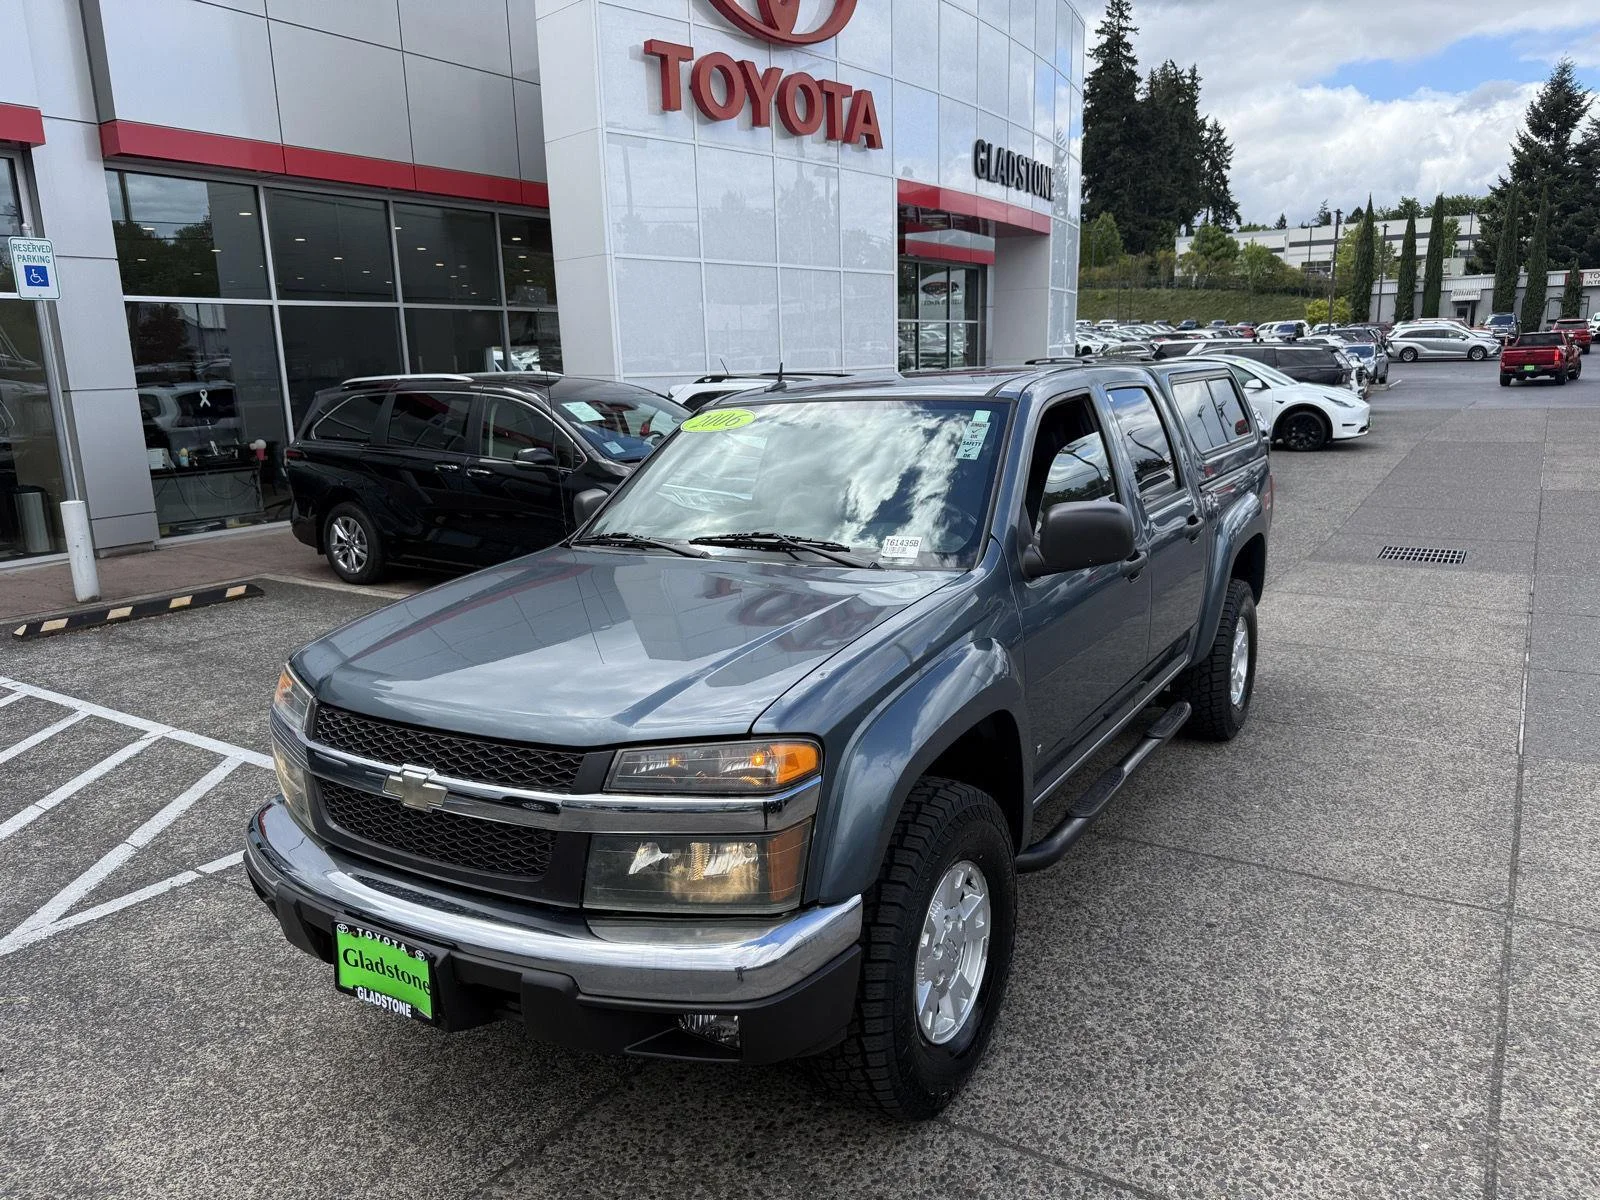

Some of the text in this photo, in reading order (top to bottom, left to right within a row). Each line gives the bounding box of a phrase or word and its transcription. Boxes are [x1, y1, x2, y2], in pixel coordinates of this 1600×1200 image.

[643, 39, 883, 149] TOYOTA
[974, 139, 1054, 202] GLADSTONE
[12, 243, 52, 253] RESERVED
[17, 254, 51, 263] PARKING
[356, 928, 408, 953] TOYOTA
[342, 948, 431, 996] Gladstone
[356, 986, 412, 1018] GLADSTONE
